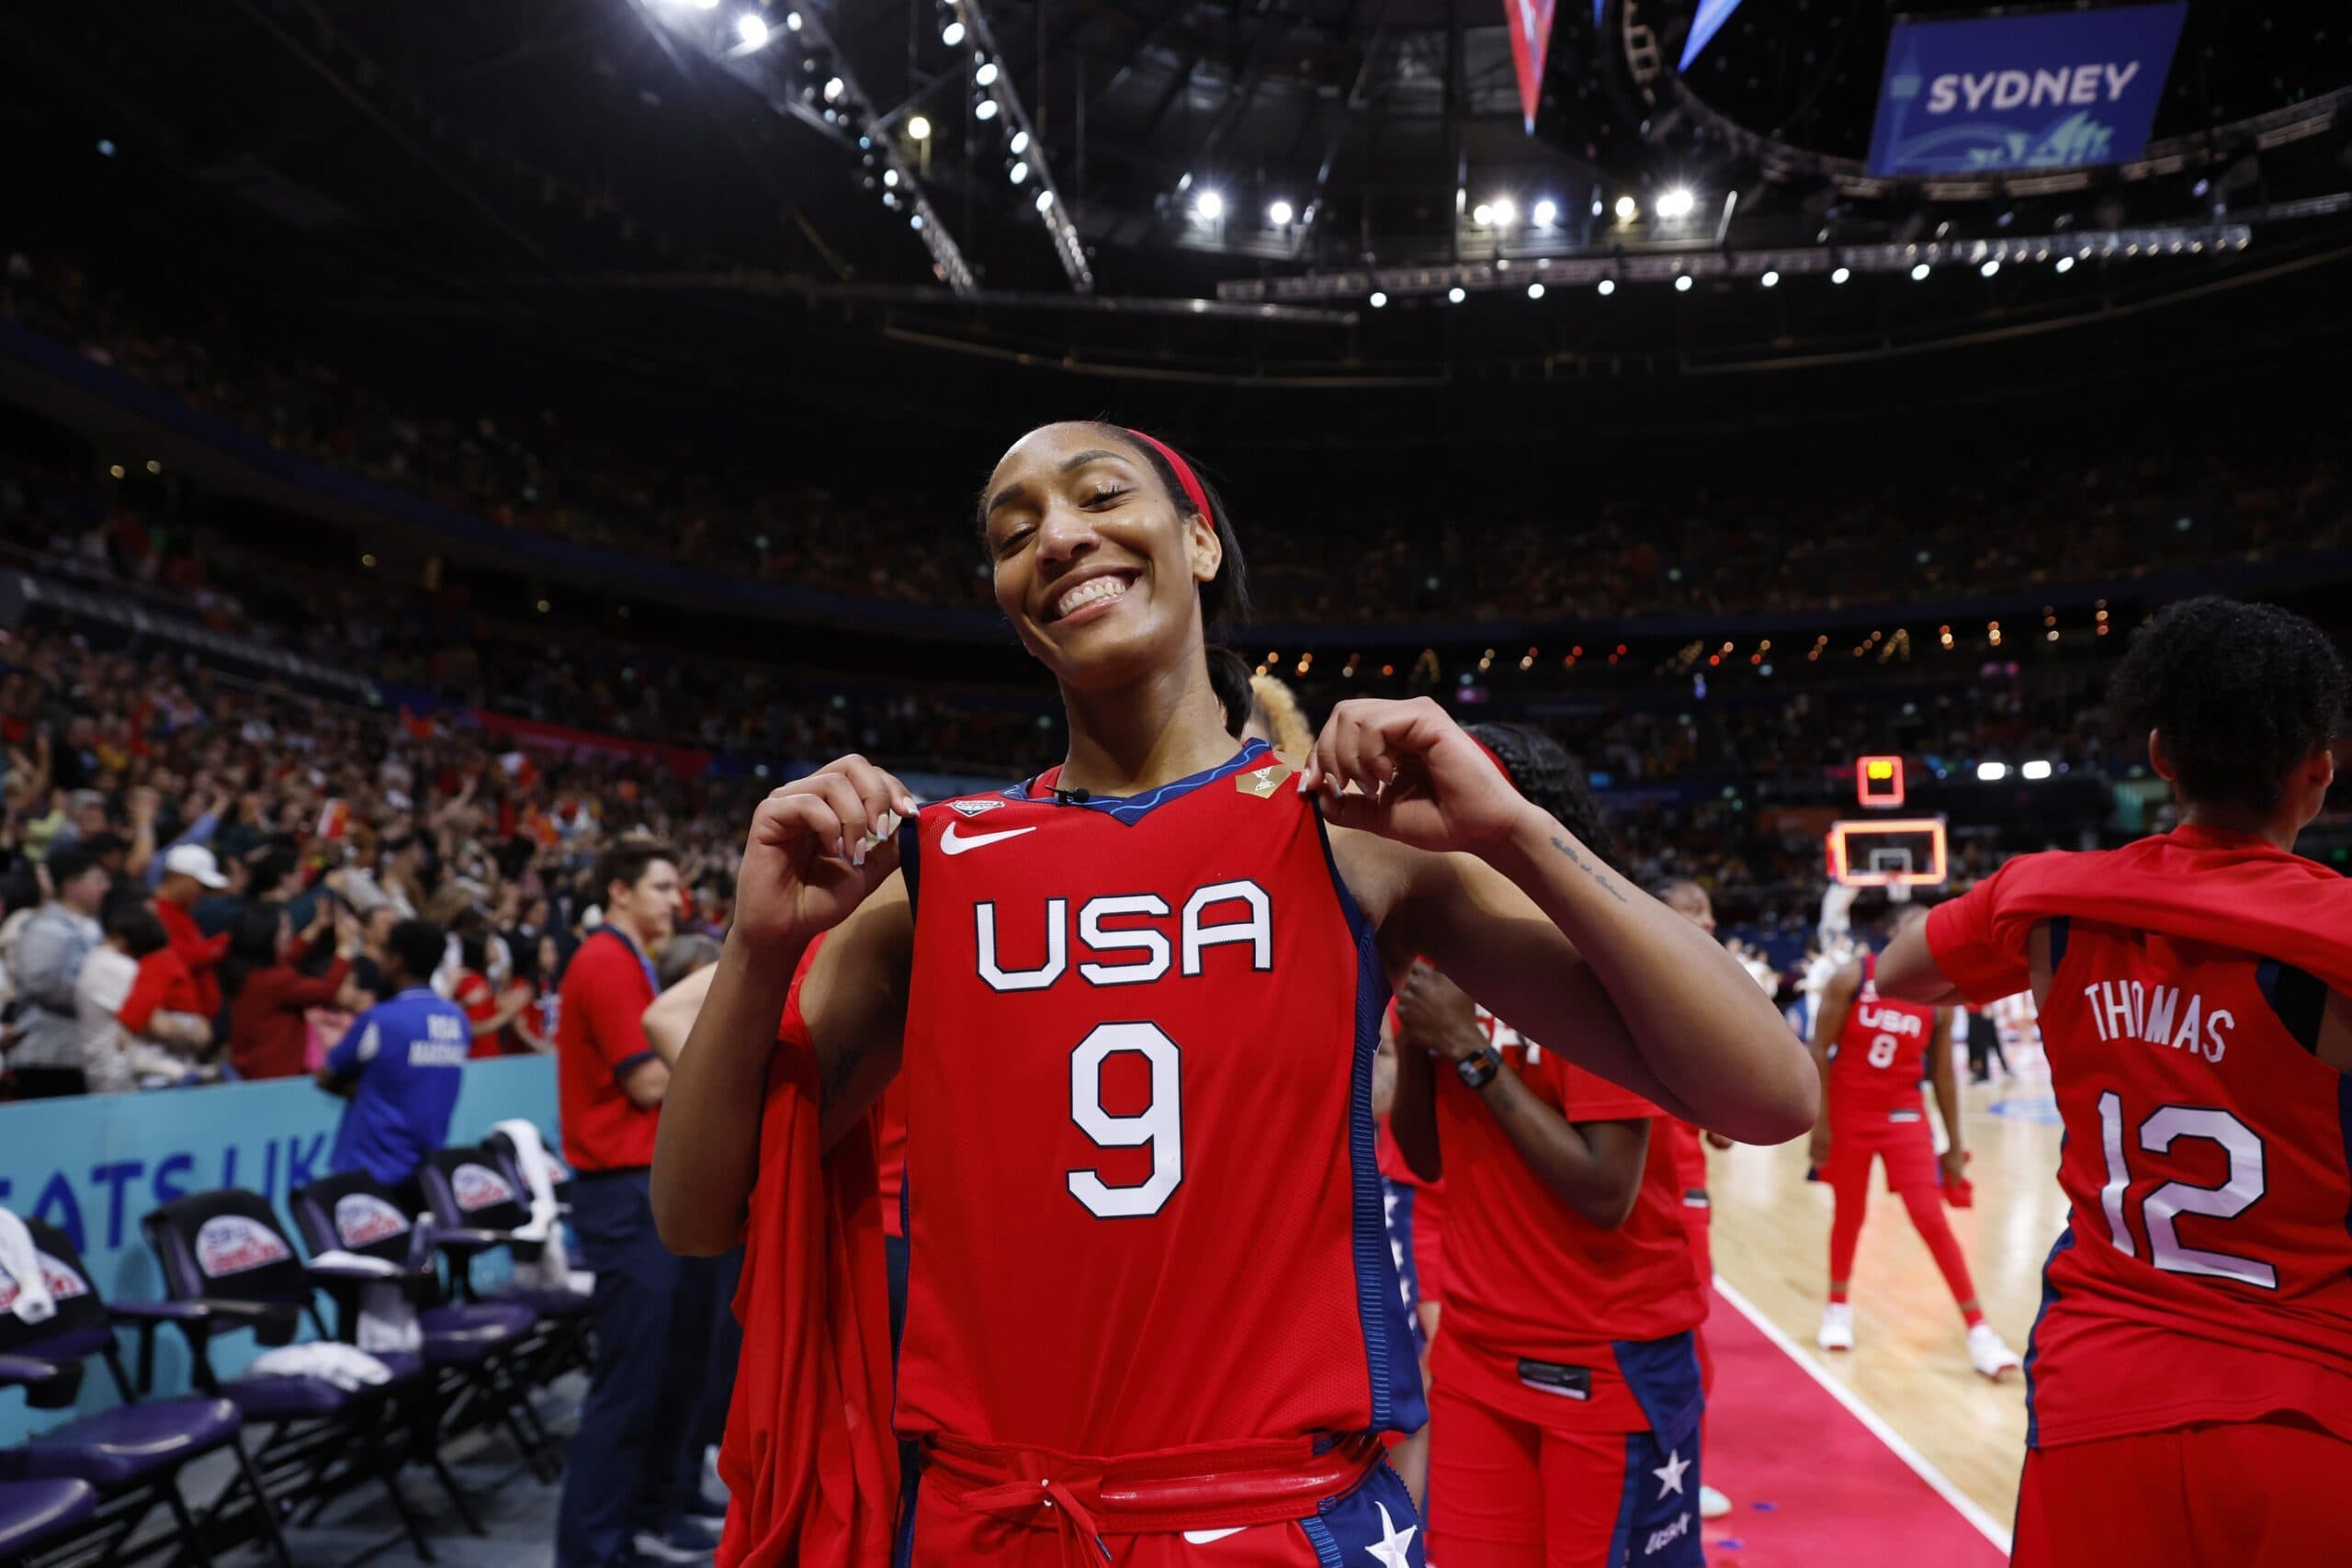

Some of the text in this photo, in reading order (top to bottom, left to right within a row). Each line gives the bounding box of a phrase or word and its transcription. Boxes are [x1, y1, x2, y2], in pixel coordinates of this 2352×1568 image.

[1928, 62, 2139, 114] SYDNEY
[975, 877, 1273, 993] USA
[1859, 1004, 1922, 1039] USA
[1868, 1032, 1898, 1069] 8
[2085, 979, 2235, 1064] THOMAS
[1067, 1021, 1183, 1219] 9
[0, 1152, 196, 1257] ATS
[2097, 1089, 2278, 1291] 12
